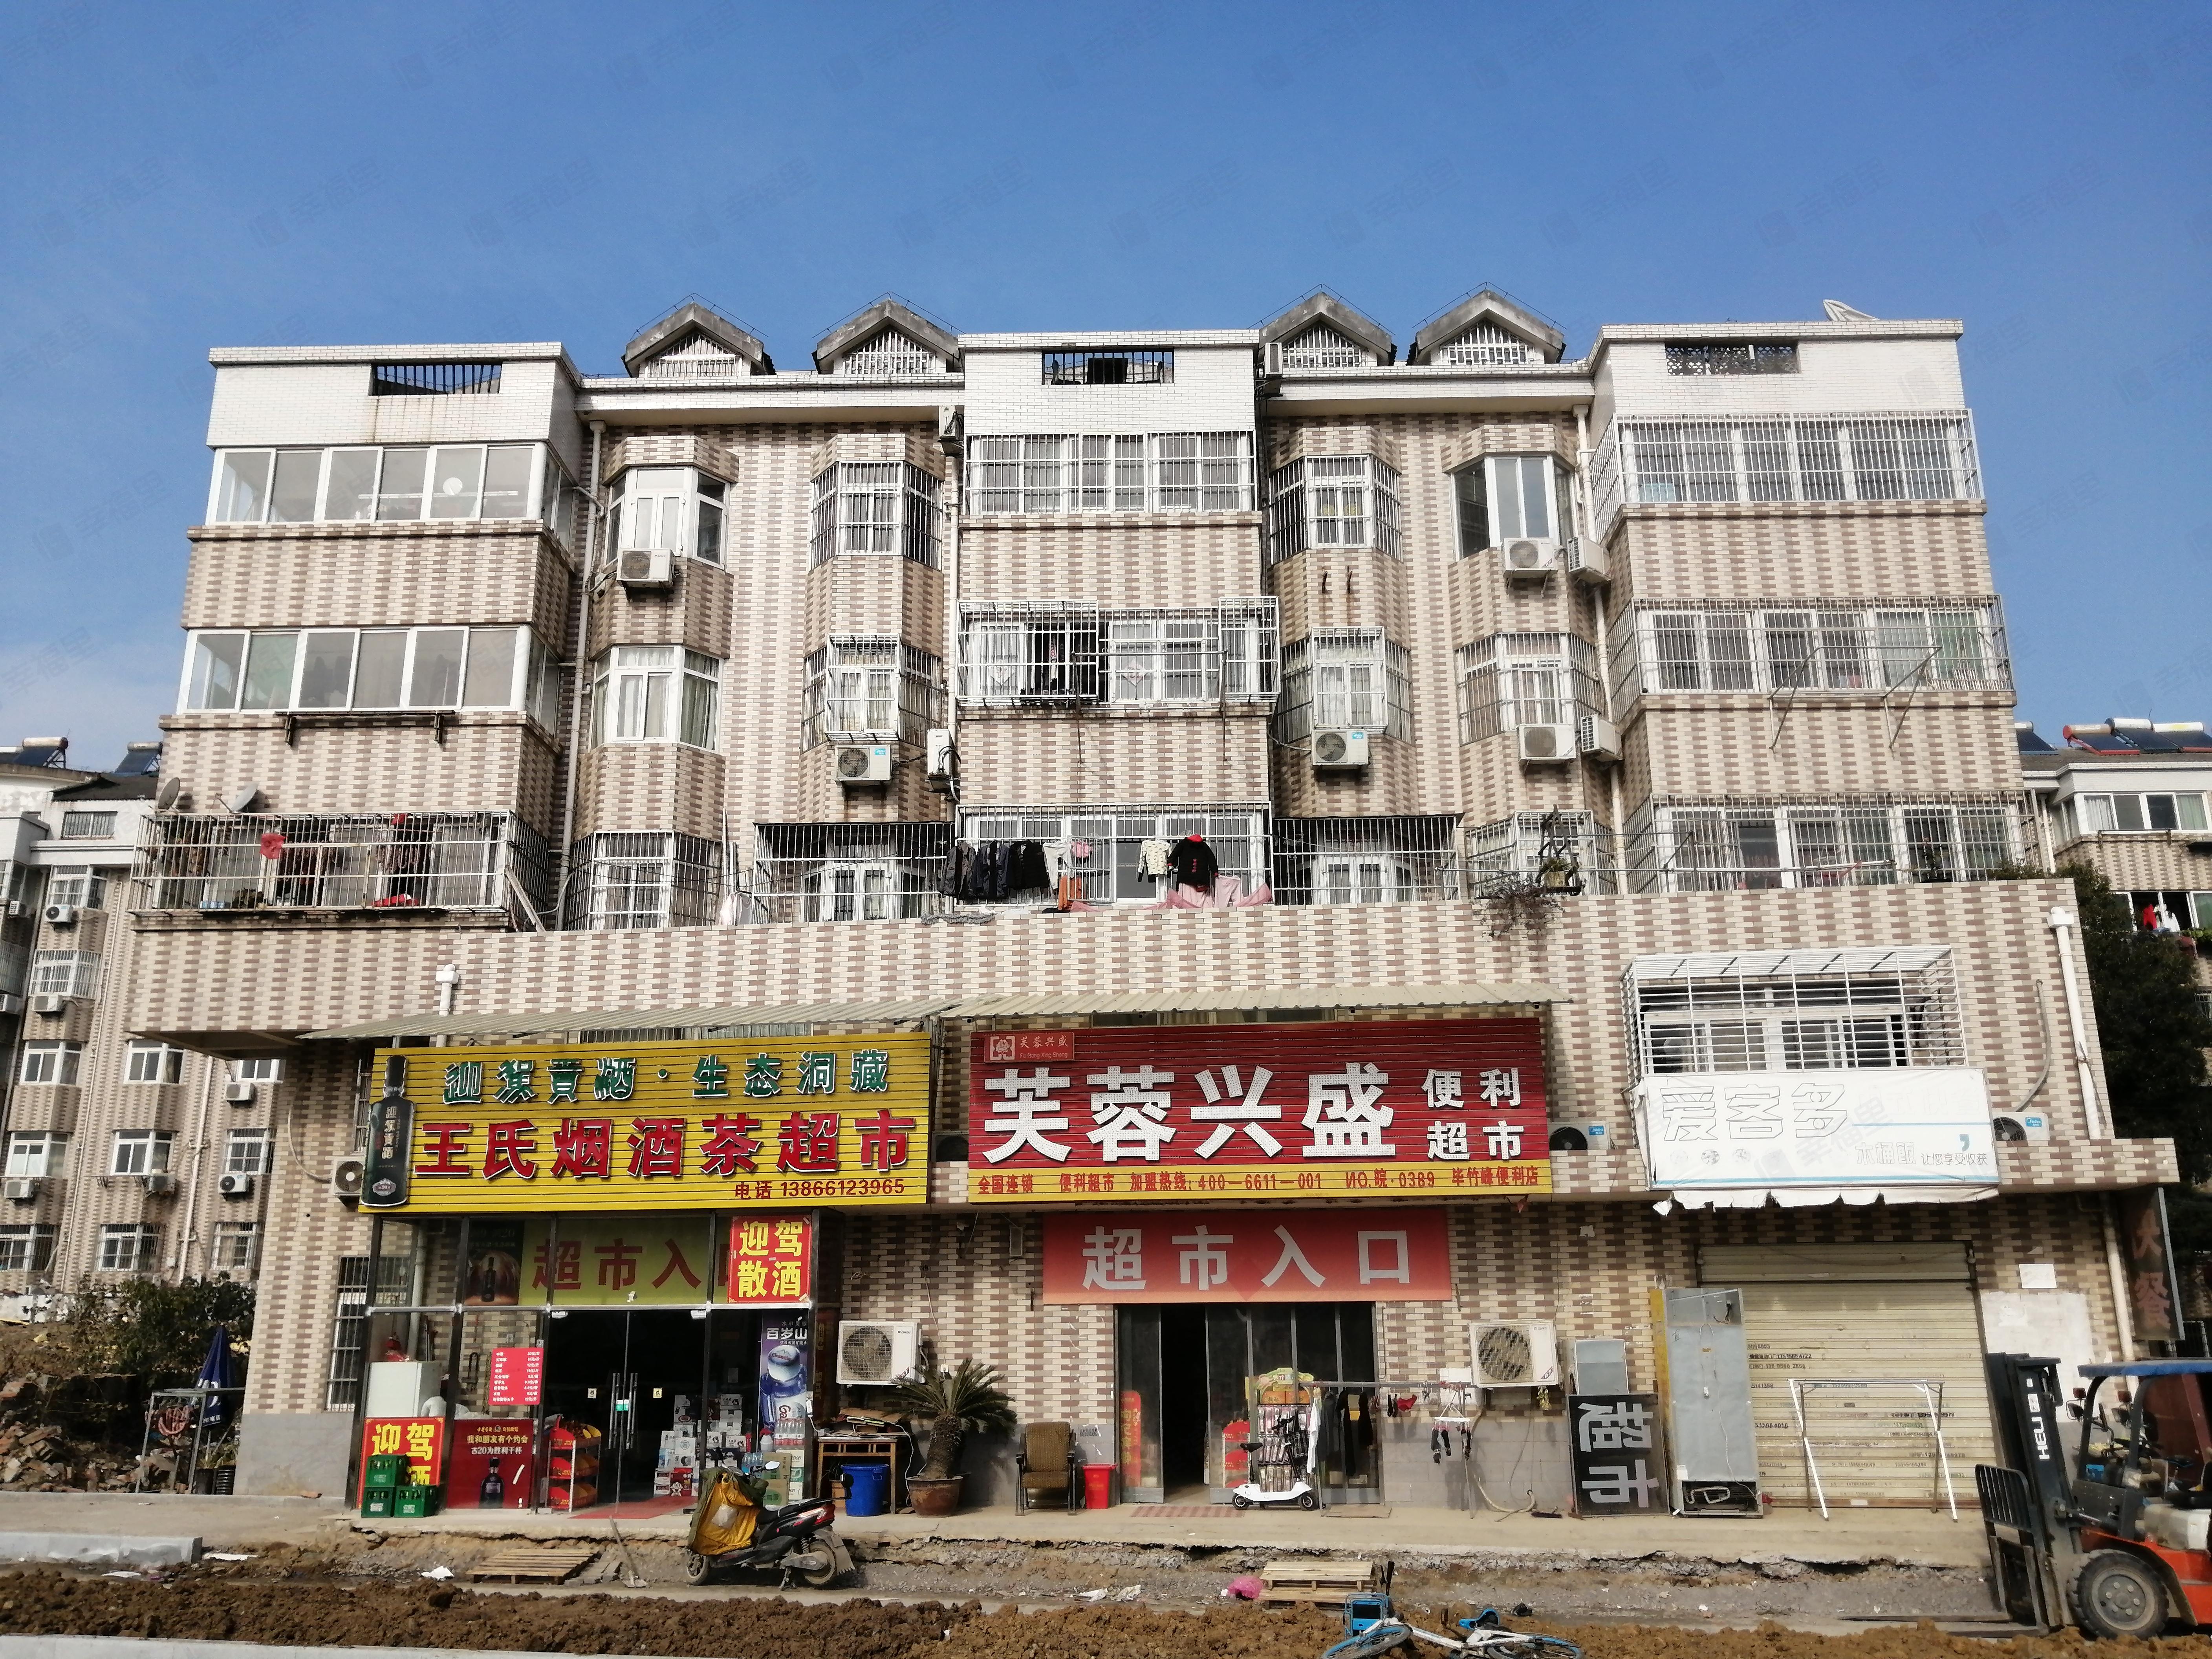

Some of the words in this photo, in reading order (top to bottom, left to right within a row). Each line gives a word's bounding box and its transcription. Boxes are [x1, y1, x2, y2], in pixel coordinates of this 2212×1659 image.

[1020, 1035, 1068, 1048] 芙蓉兴盛
[1422, 1067, 1520, 1108] 便利
[983, 1062, 1395, 1162] 芙蓉兴盛
[1661, 1082, 1848, 1141] 爱客多
[414, 1109, 917, 1179] 王氏烟酒茶超市
[1427, 1119, 1524, 1161] 超市
[1921, 1153, 1989, 1166] 让您享受收获
[734, 1181, 773, 1199] 电话
[780, 1178, 905, 1198] 13866123965
[978, 1174, 1033, 1194] 全国连锁
[1059, 1172, 1115, 1192] 便利超市
[739, 1221, 804, 1257] 迎驾
[1082, 1224, 1410, 1291] 超市入口
[532, 1238, 730, 1291] 超市入
[737, 1260, 802, 1298] 散酒
[767, 1327, 807, 1340] 百岁山
[372, 1423, 435, 1461] 迎驾
[466, 1435, 528, 1444] 我和朋友有个约会
[1577, 1401, 1660, 1508] 超市
